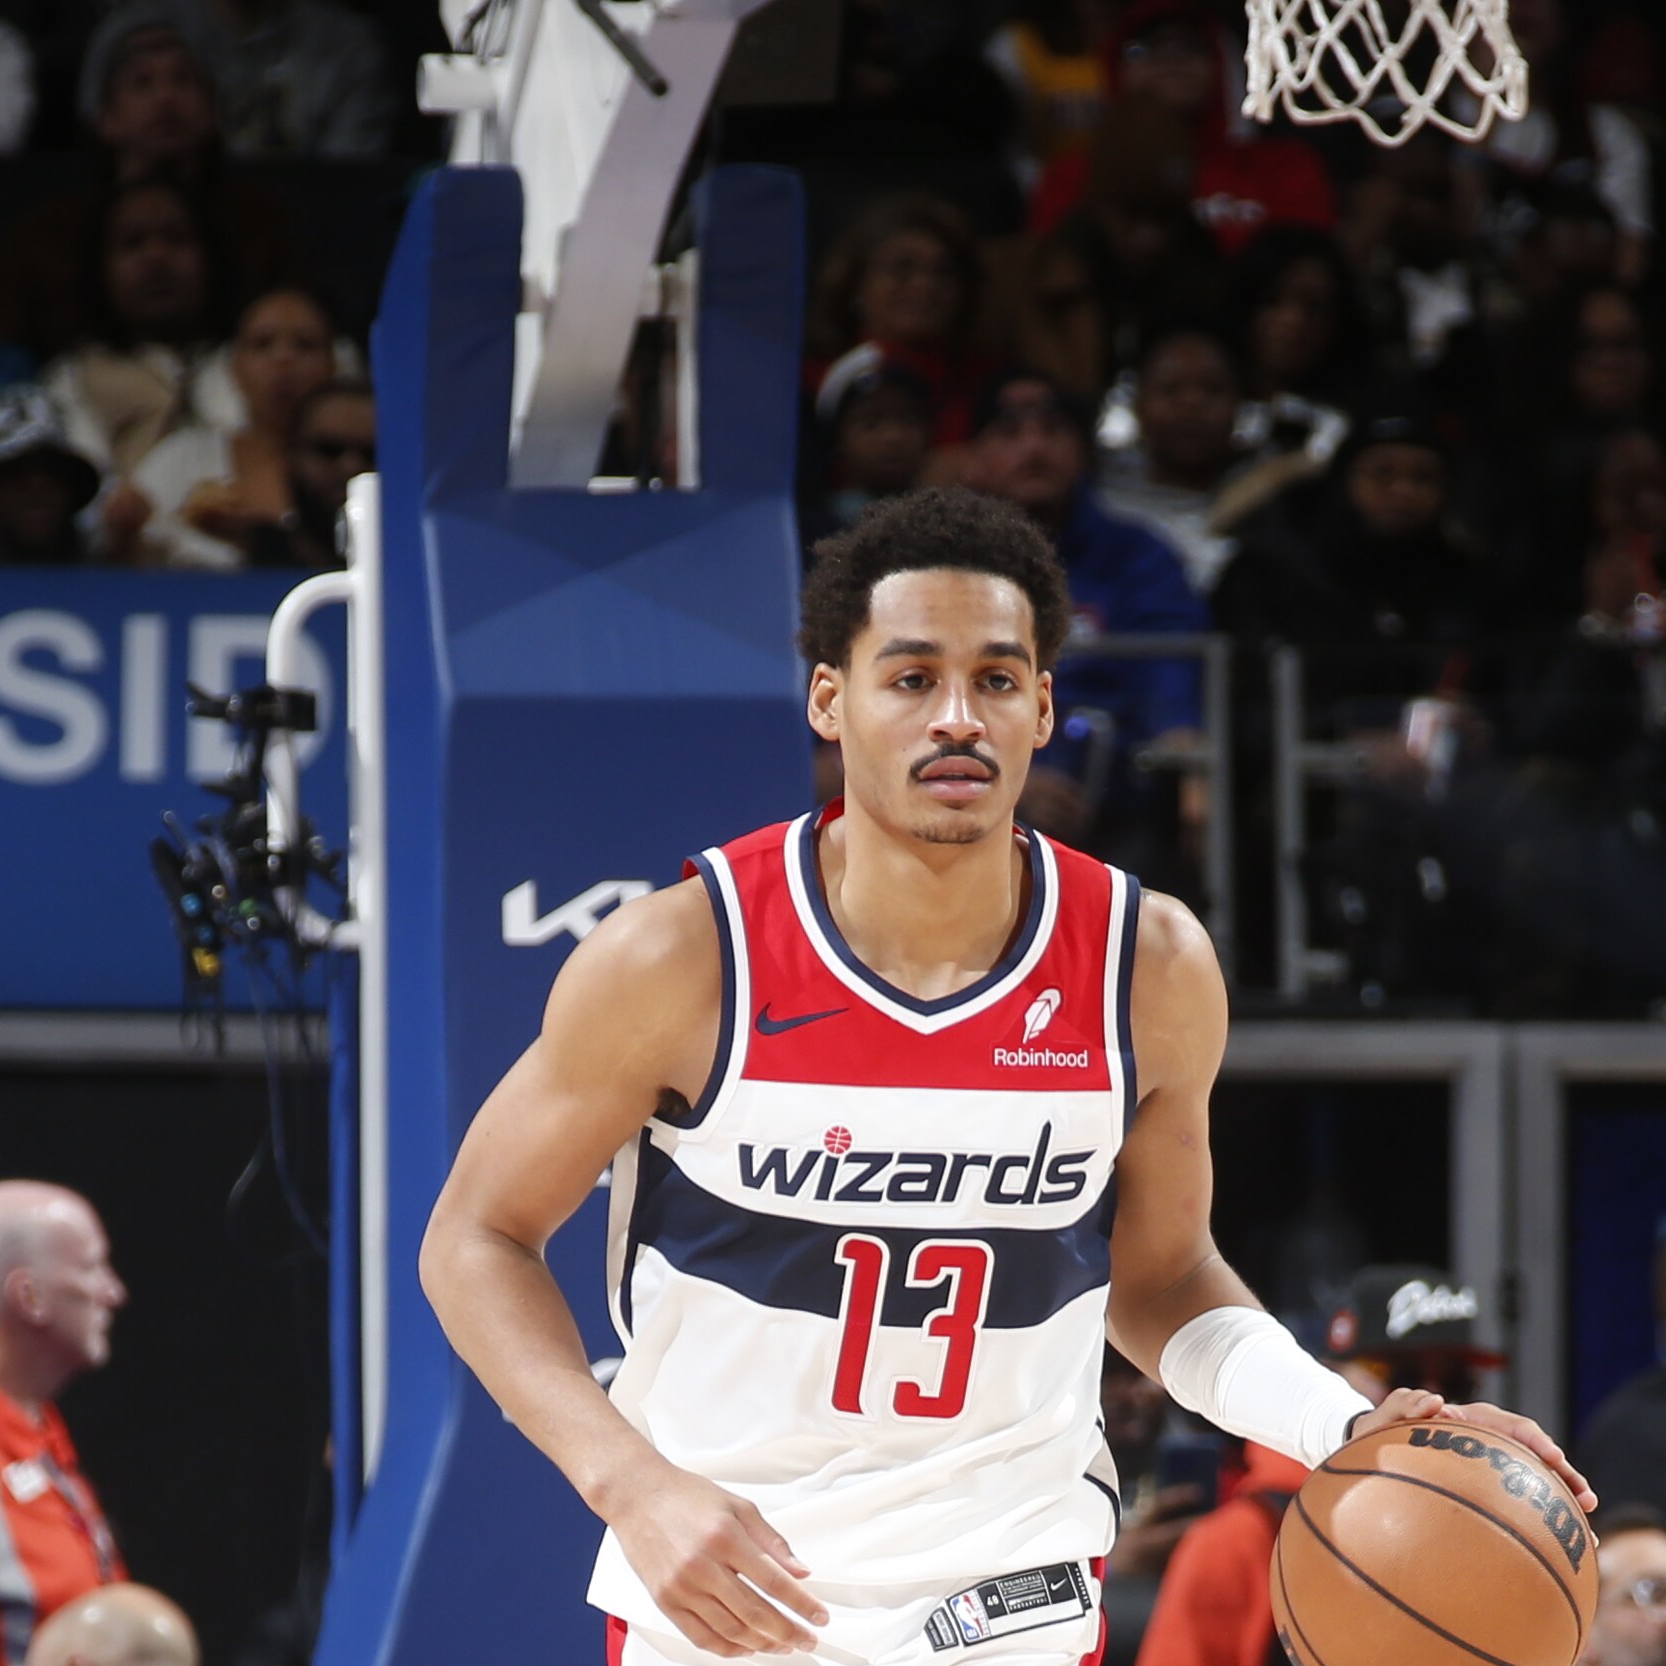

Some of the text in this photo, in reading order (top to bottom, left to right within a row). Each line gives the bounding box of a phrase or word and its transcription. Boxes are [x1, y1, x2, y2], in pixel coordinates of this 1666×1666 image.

[993, 1045, 1090, 1070] Robinhood
[737, 1119, 1097, 1206] wizards
[831, 1233, 994, 1422] 13
